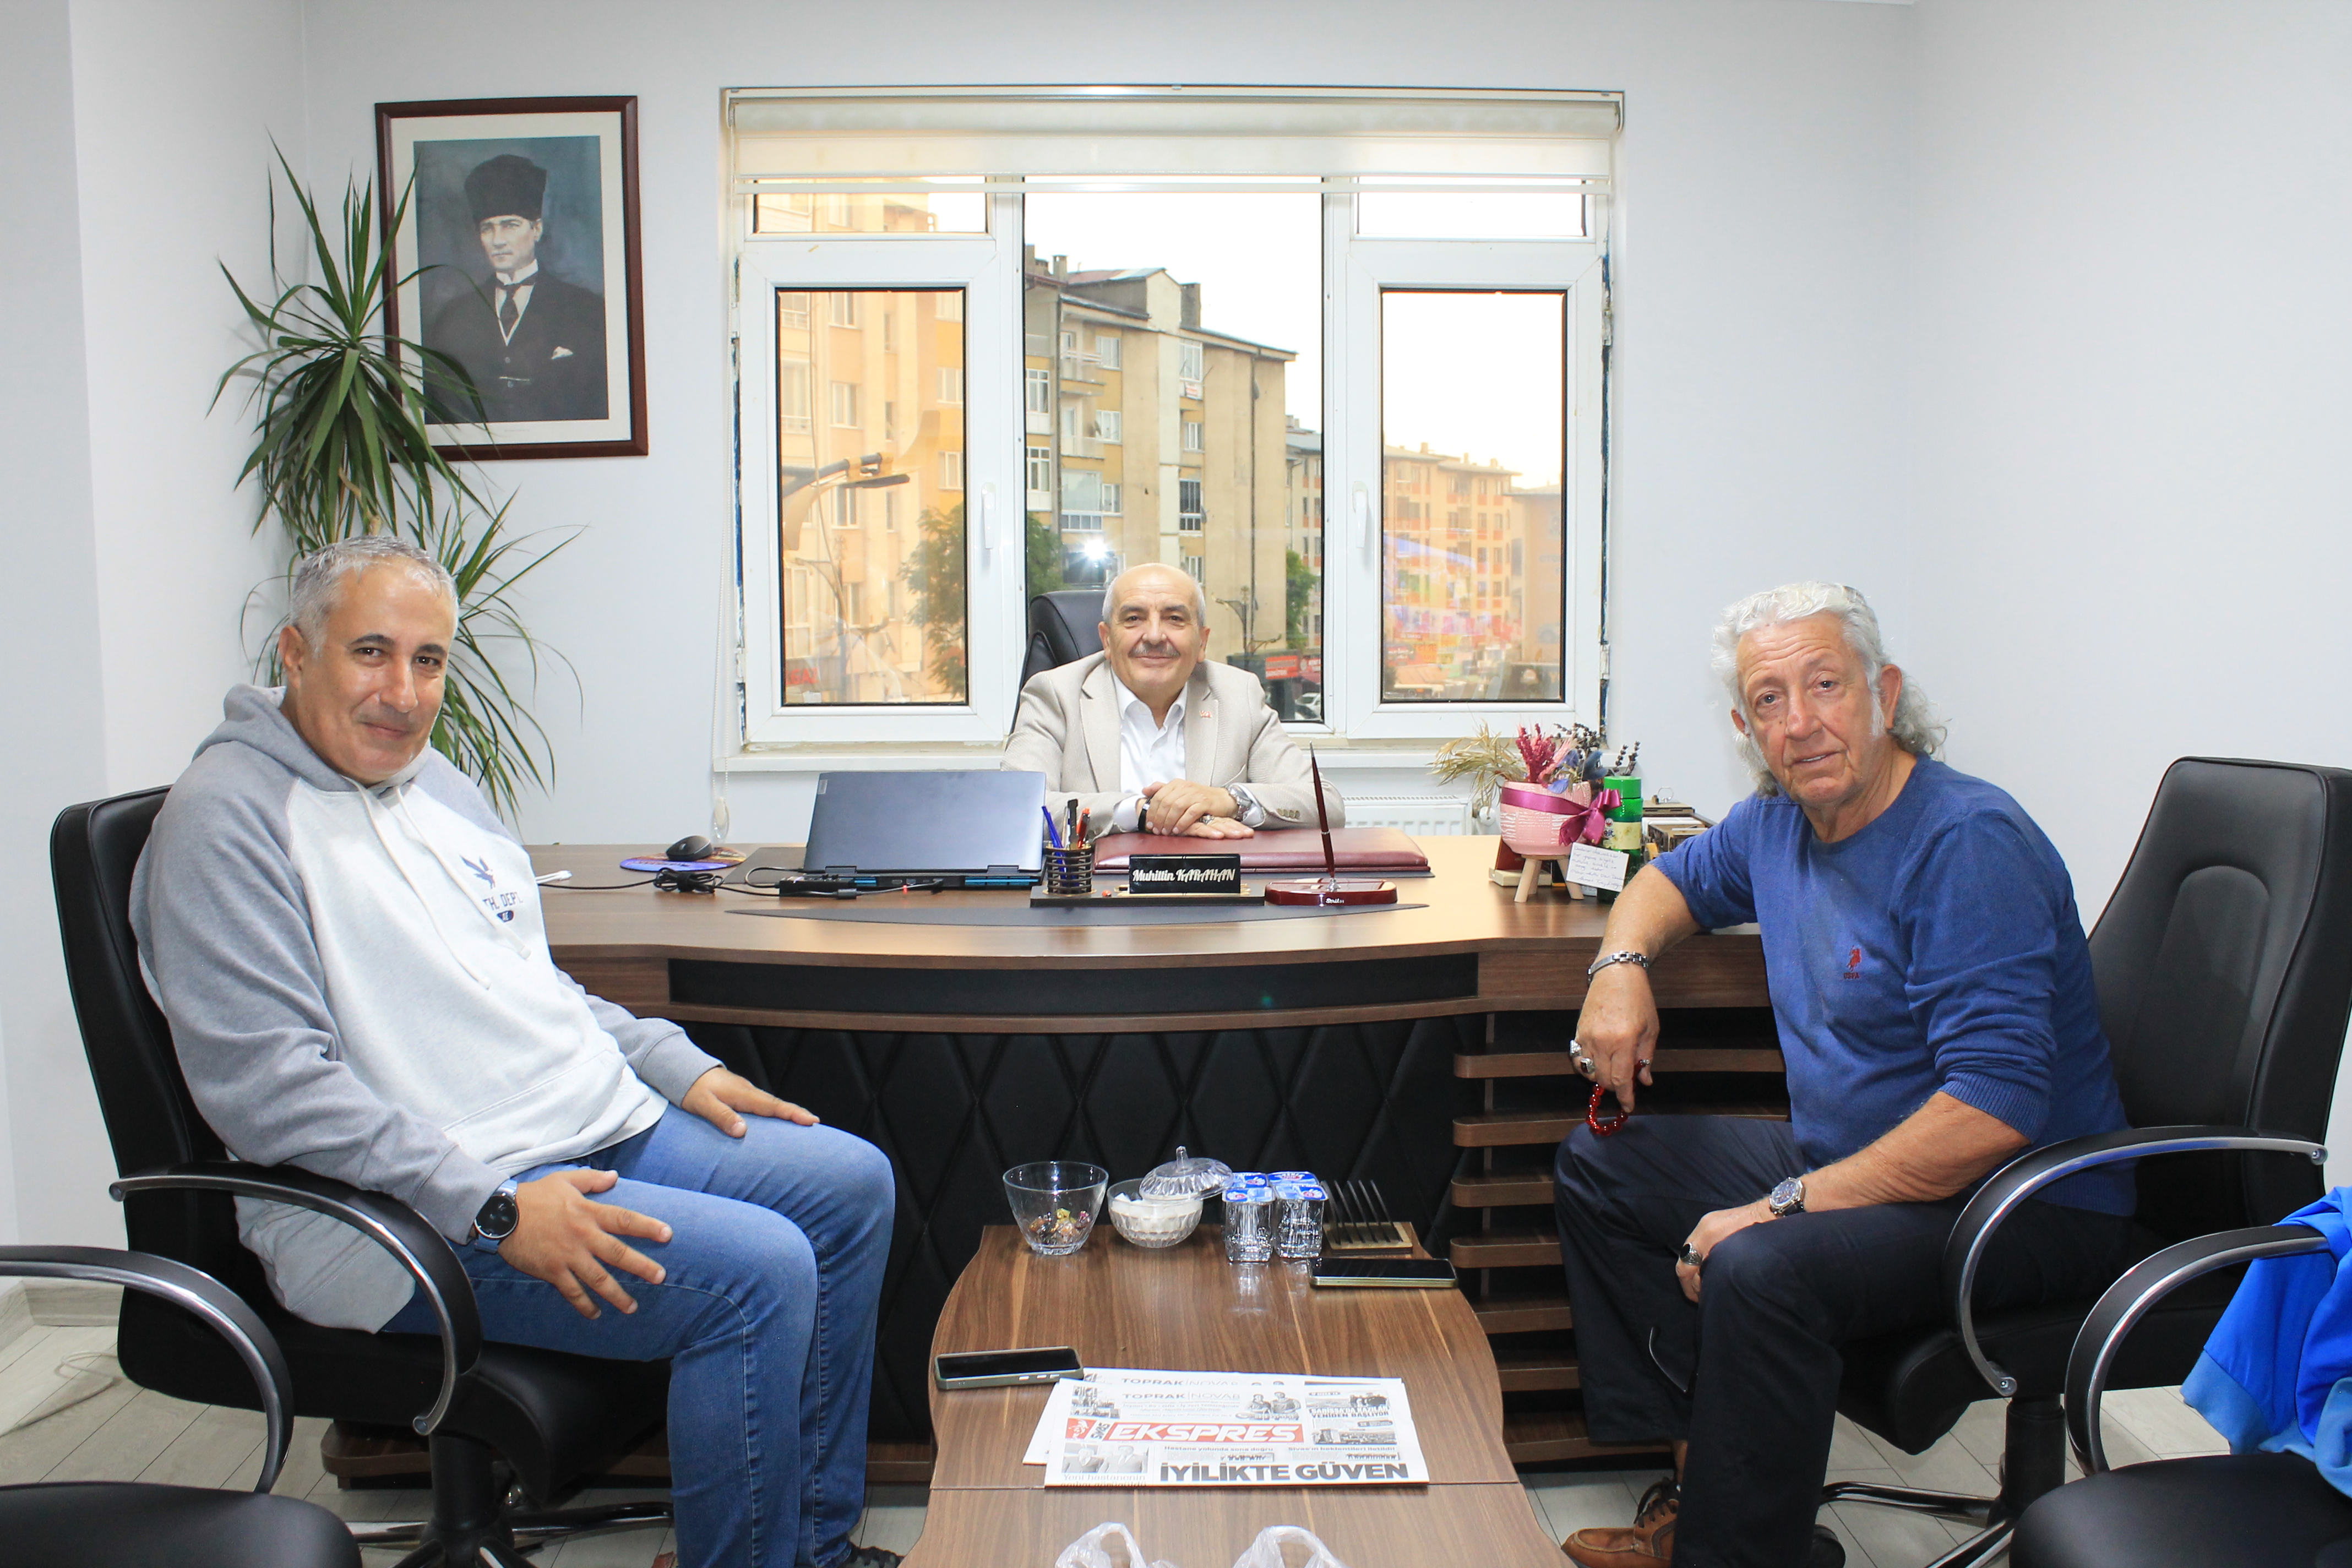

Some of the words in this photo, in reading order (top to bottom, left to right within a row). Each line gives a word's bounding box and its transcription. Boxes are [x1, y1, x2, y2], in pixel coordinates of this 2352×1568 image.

[1175, 868, 1236, 883] KARAHAN
[1121, 1378, 1184, 1386] TOPRAK
[1111, 1424, 1300, 1441] EKSPRES
[1160, 1462, 1291, 1481] İYİLİKTE
[1295, 1461, 1409, 1480] GÜVEN
